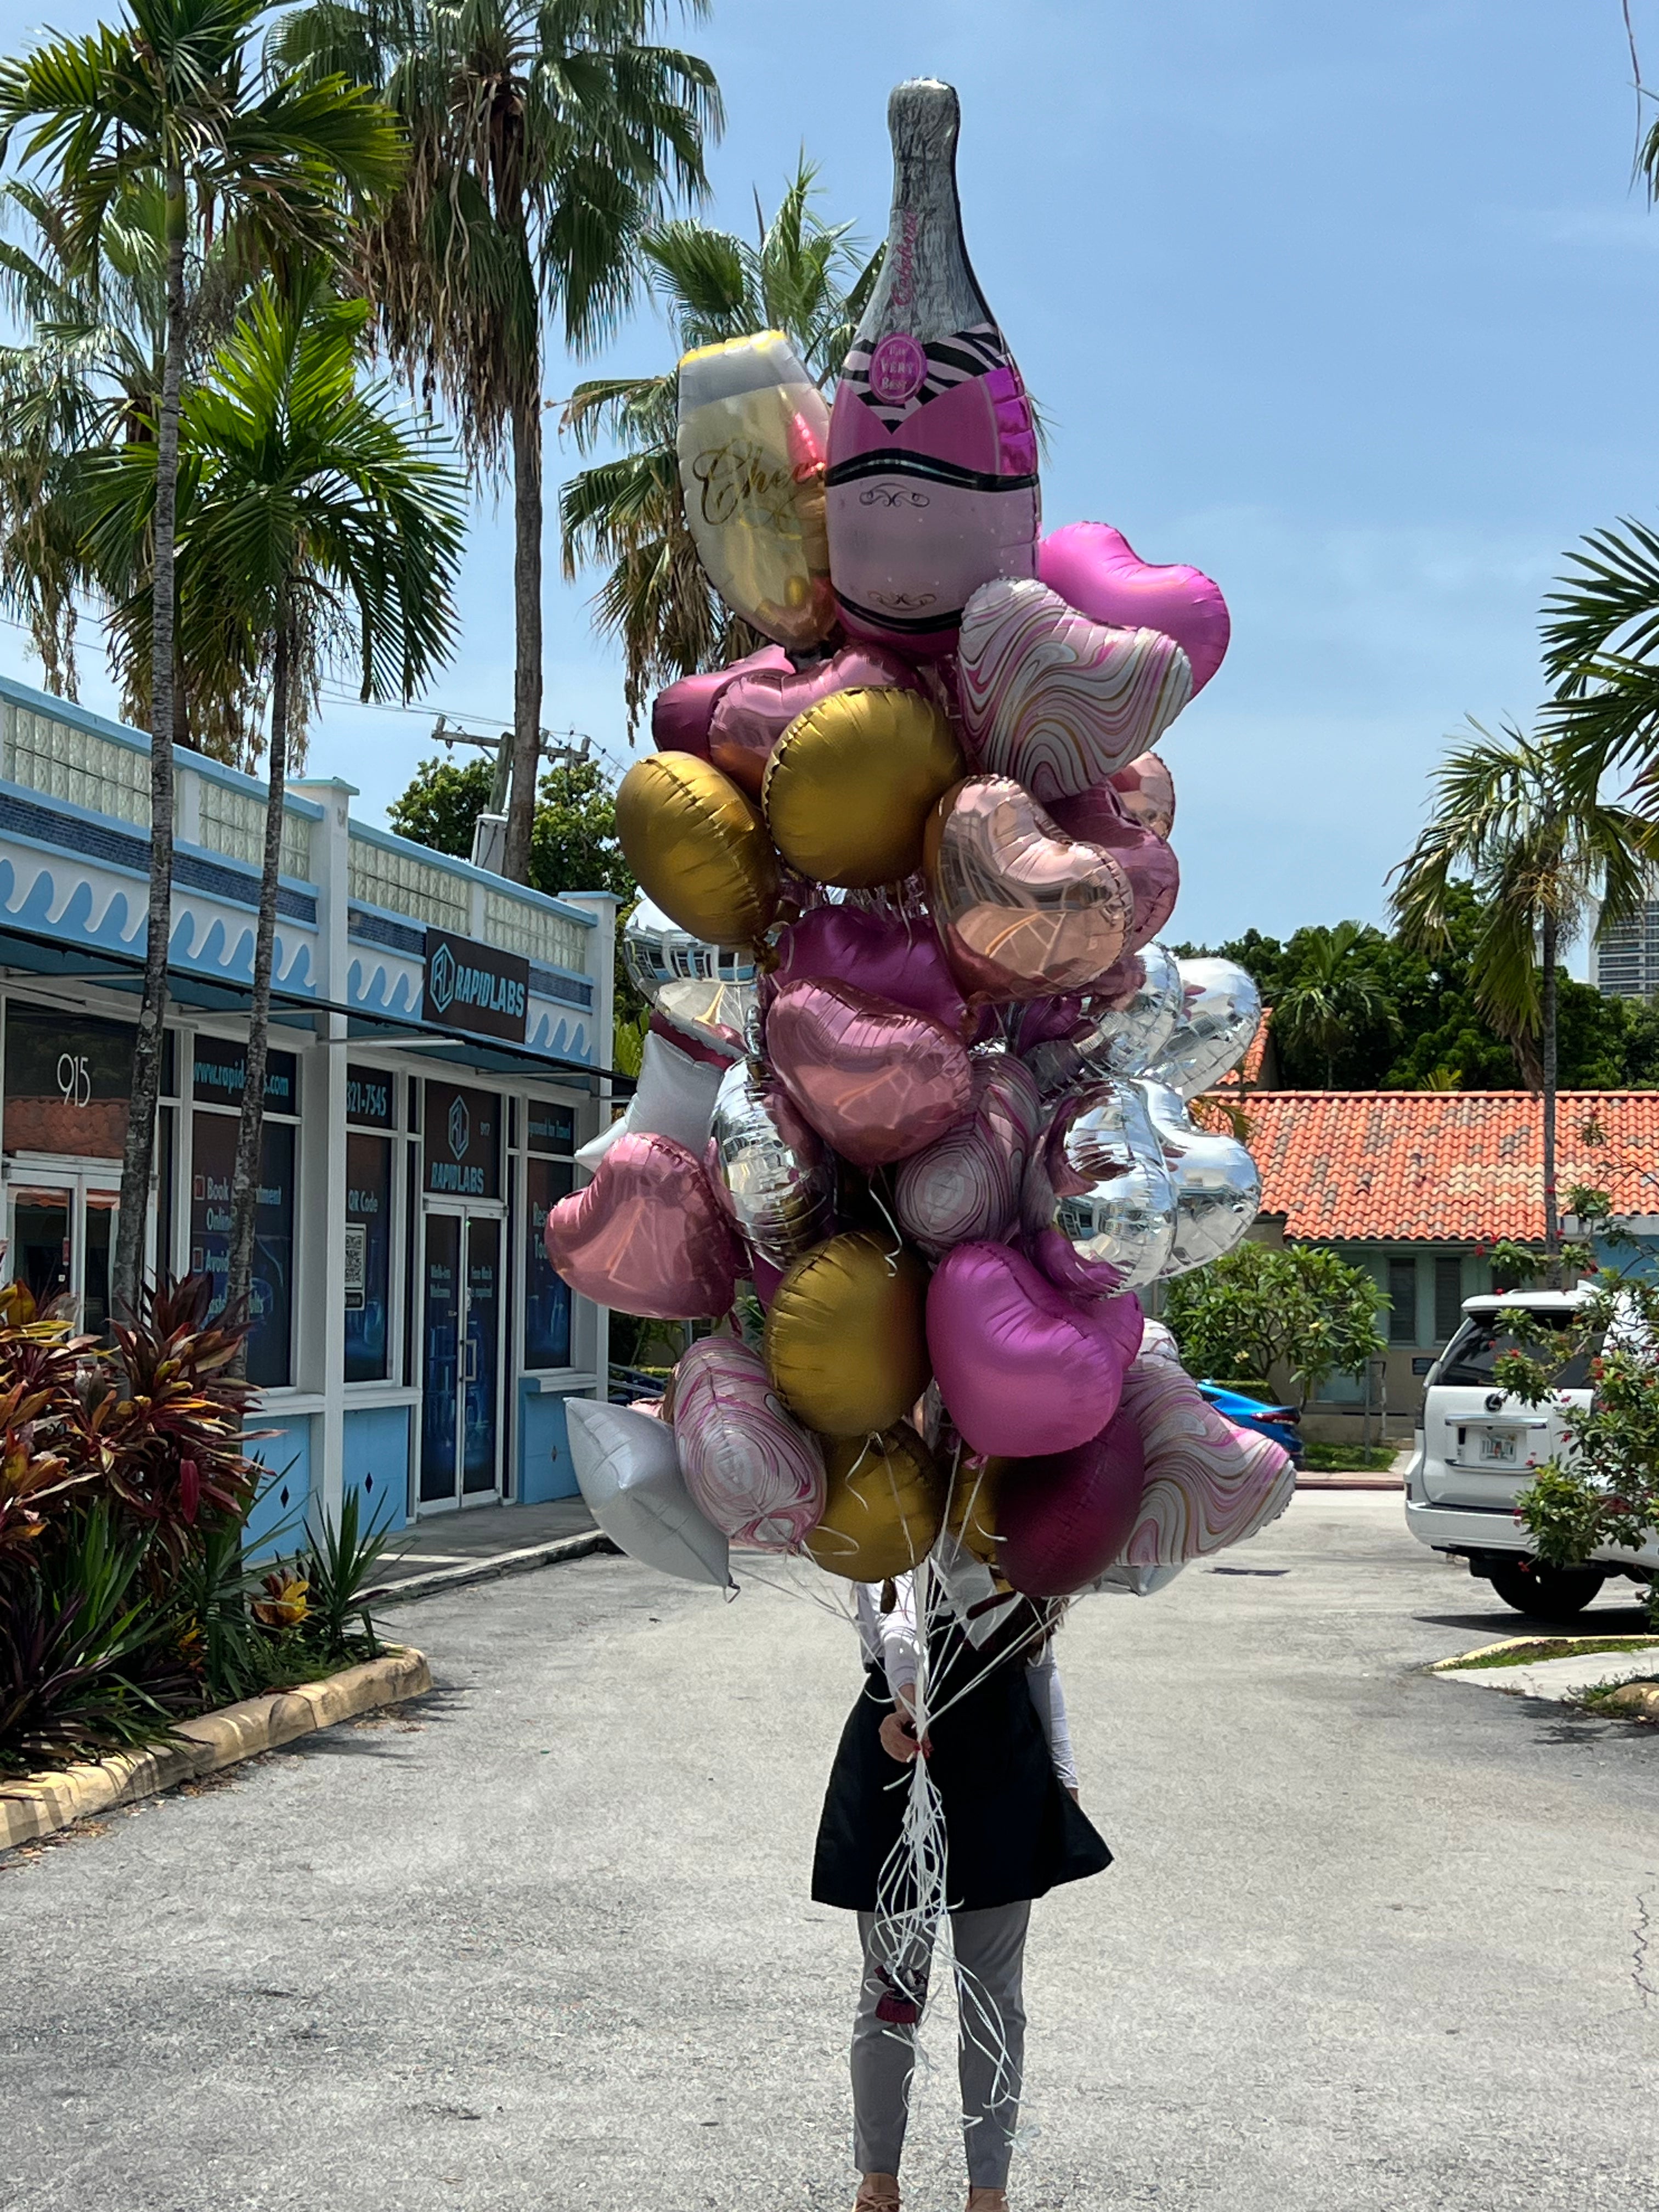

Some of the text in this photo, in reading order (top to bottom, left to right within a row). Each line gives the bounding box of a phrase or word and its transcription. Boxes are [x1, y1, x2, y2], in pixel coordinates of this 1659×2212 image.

[879, 357, 915, 375] VERY
[455, 964, 524, 1018] RAPIDLABS
[57, 1053, 91, 1107] 915
[207, 1177, 229, 1201] Book
[431, 1161, 484, 1194] RAPIDLABS
[348, 1189, 379, 1213] QR Code
